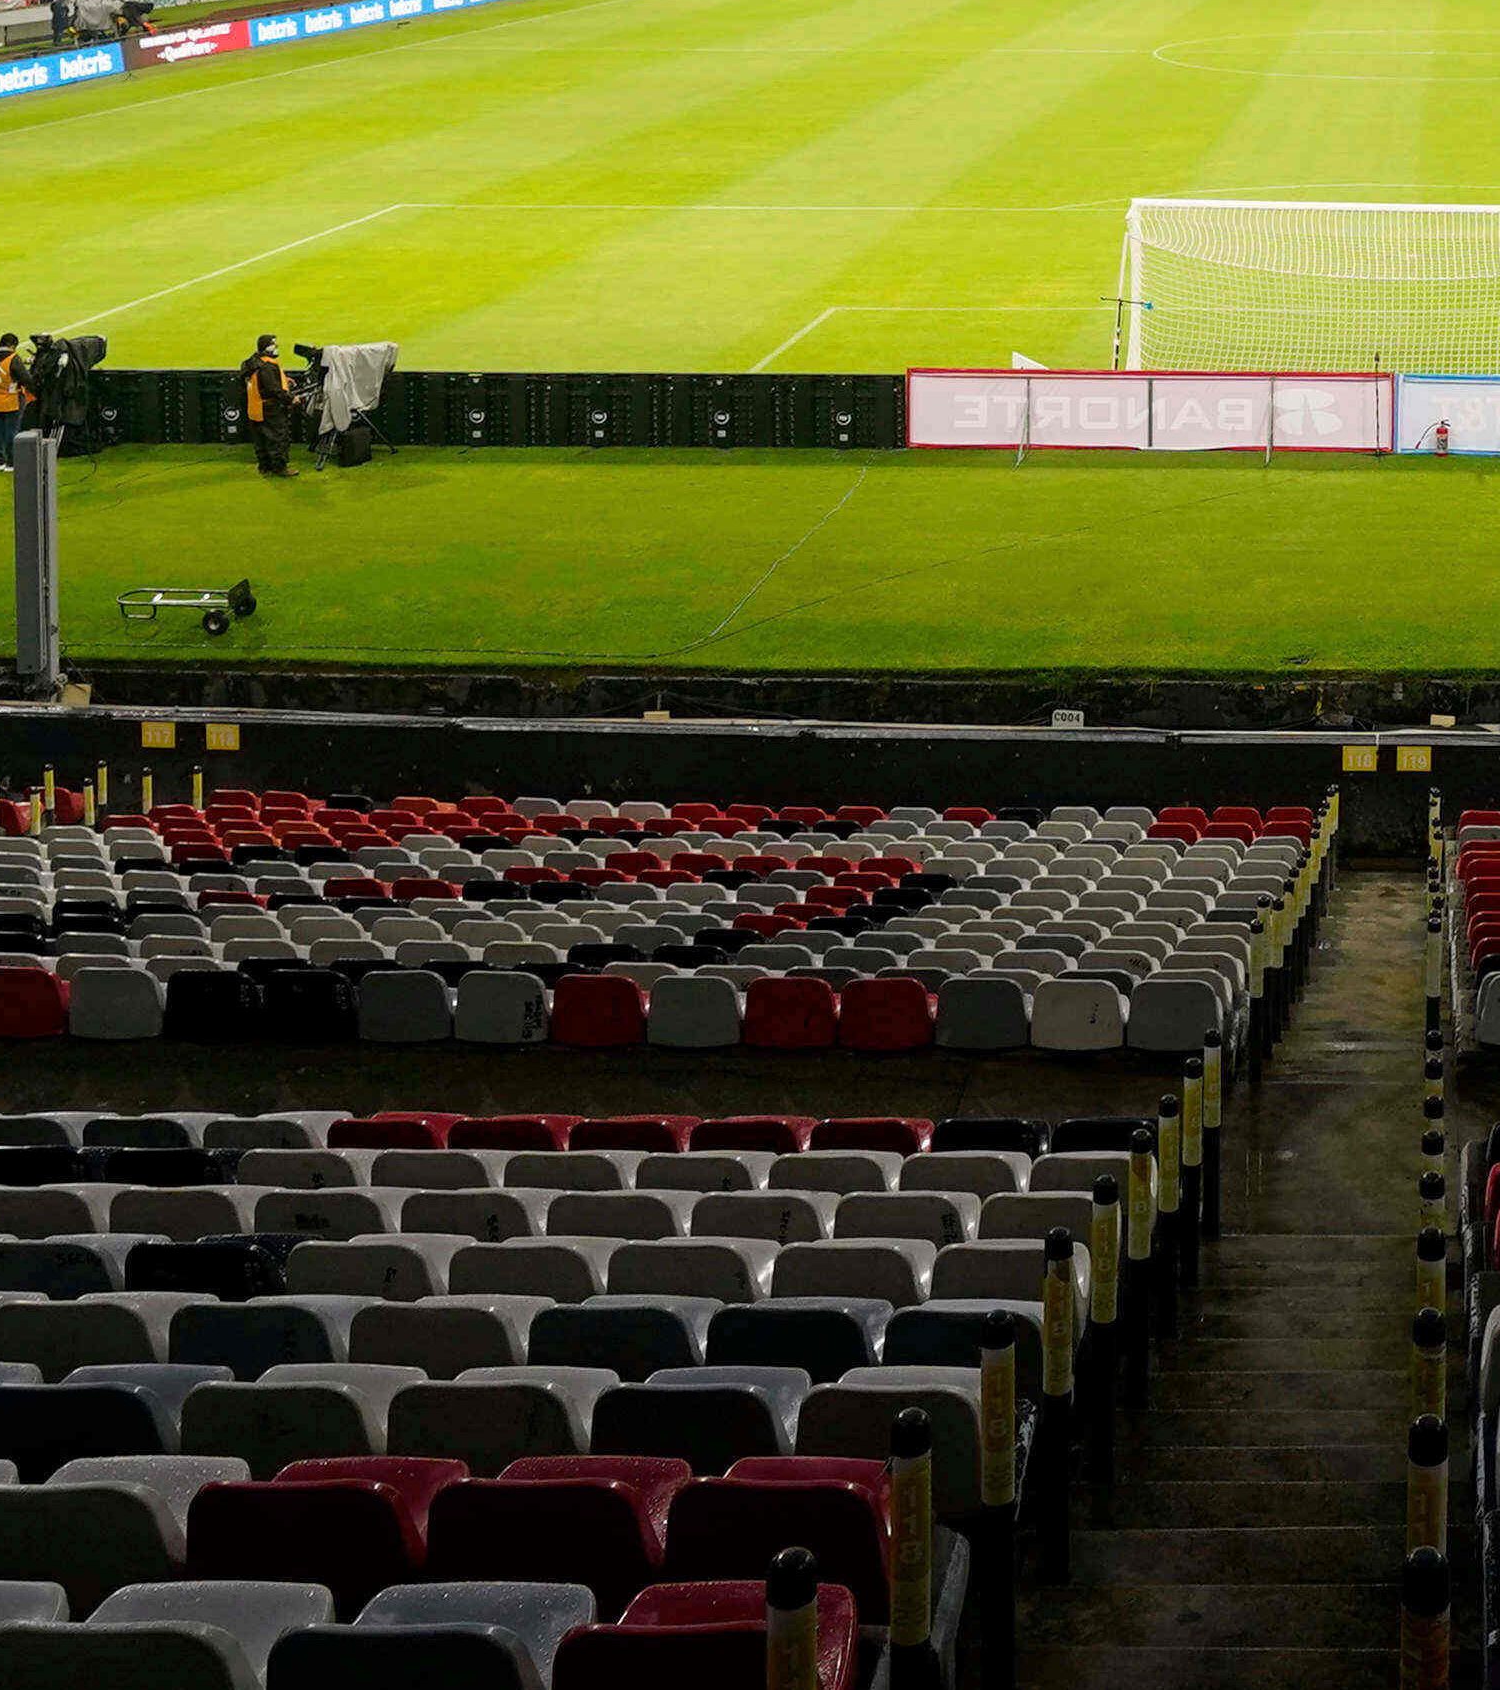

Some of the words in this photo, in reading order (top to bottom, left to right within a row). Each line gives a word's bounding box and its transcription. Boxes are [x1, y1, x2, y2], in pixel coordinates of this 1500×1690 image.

[257, 17, 298, 42] betcris
[304, 10, 343, 34] betcris
[59, 50, 113, 81] betcris
[1054, 712, 1080, 722] C004
